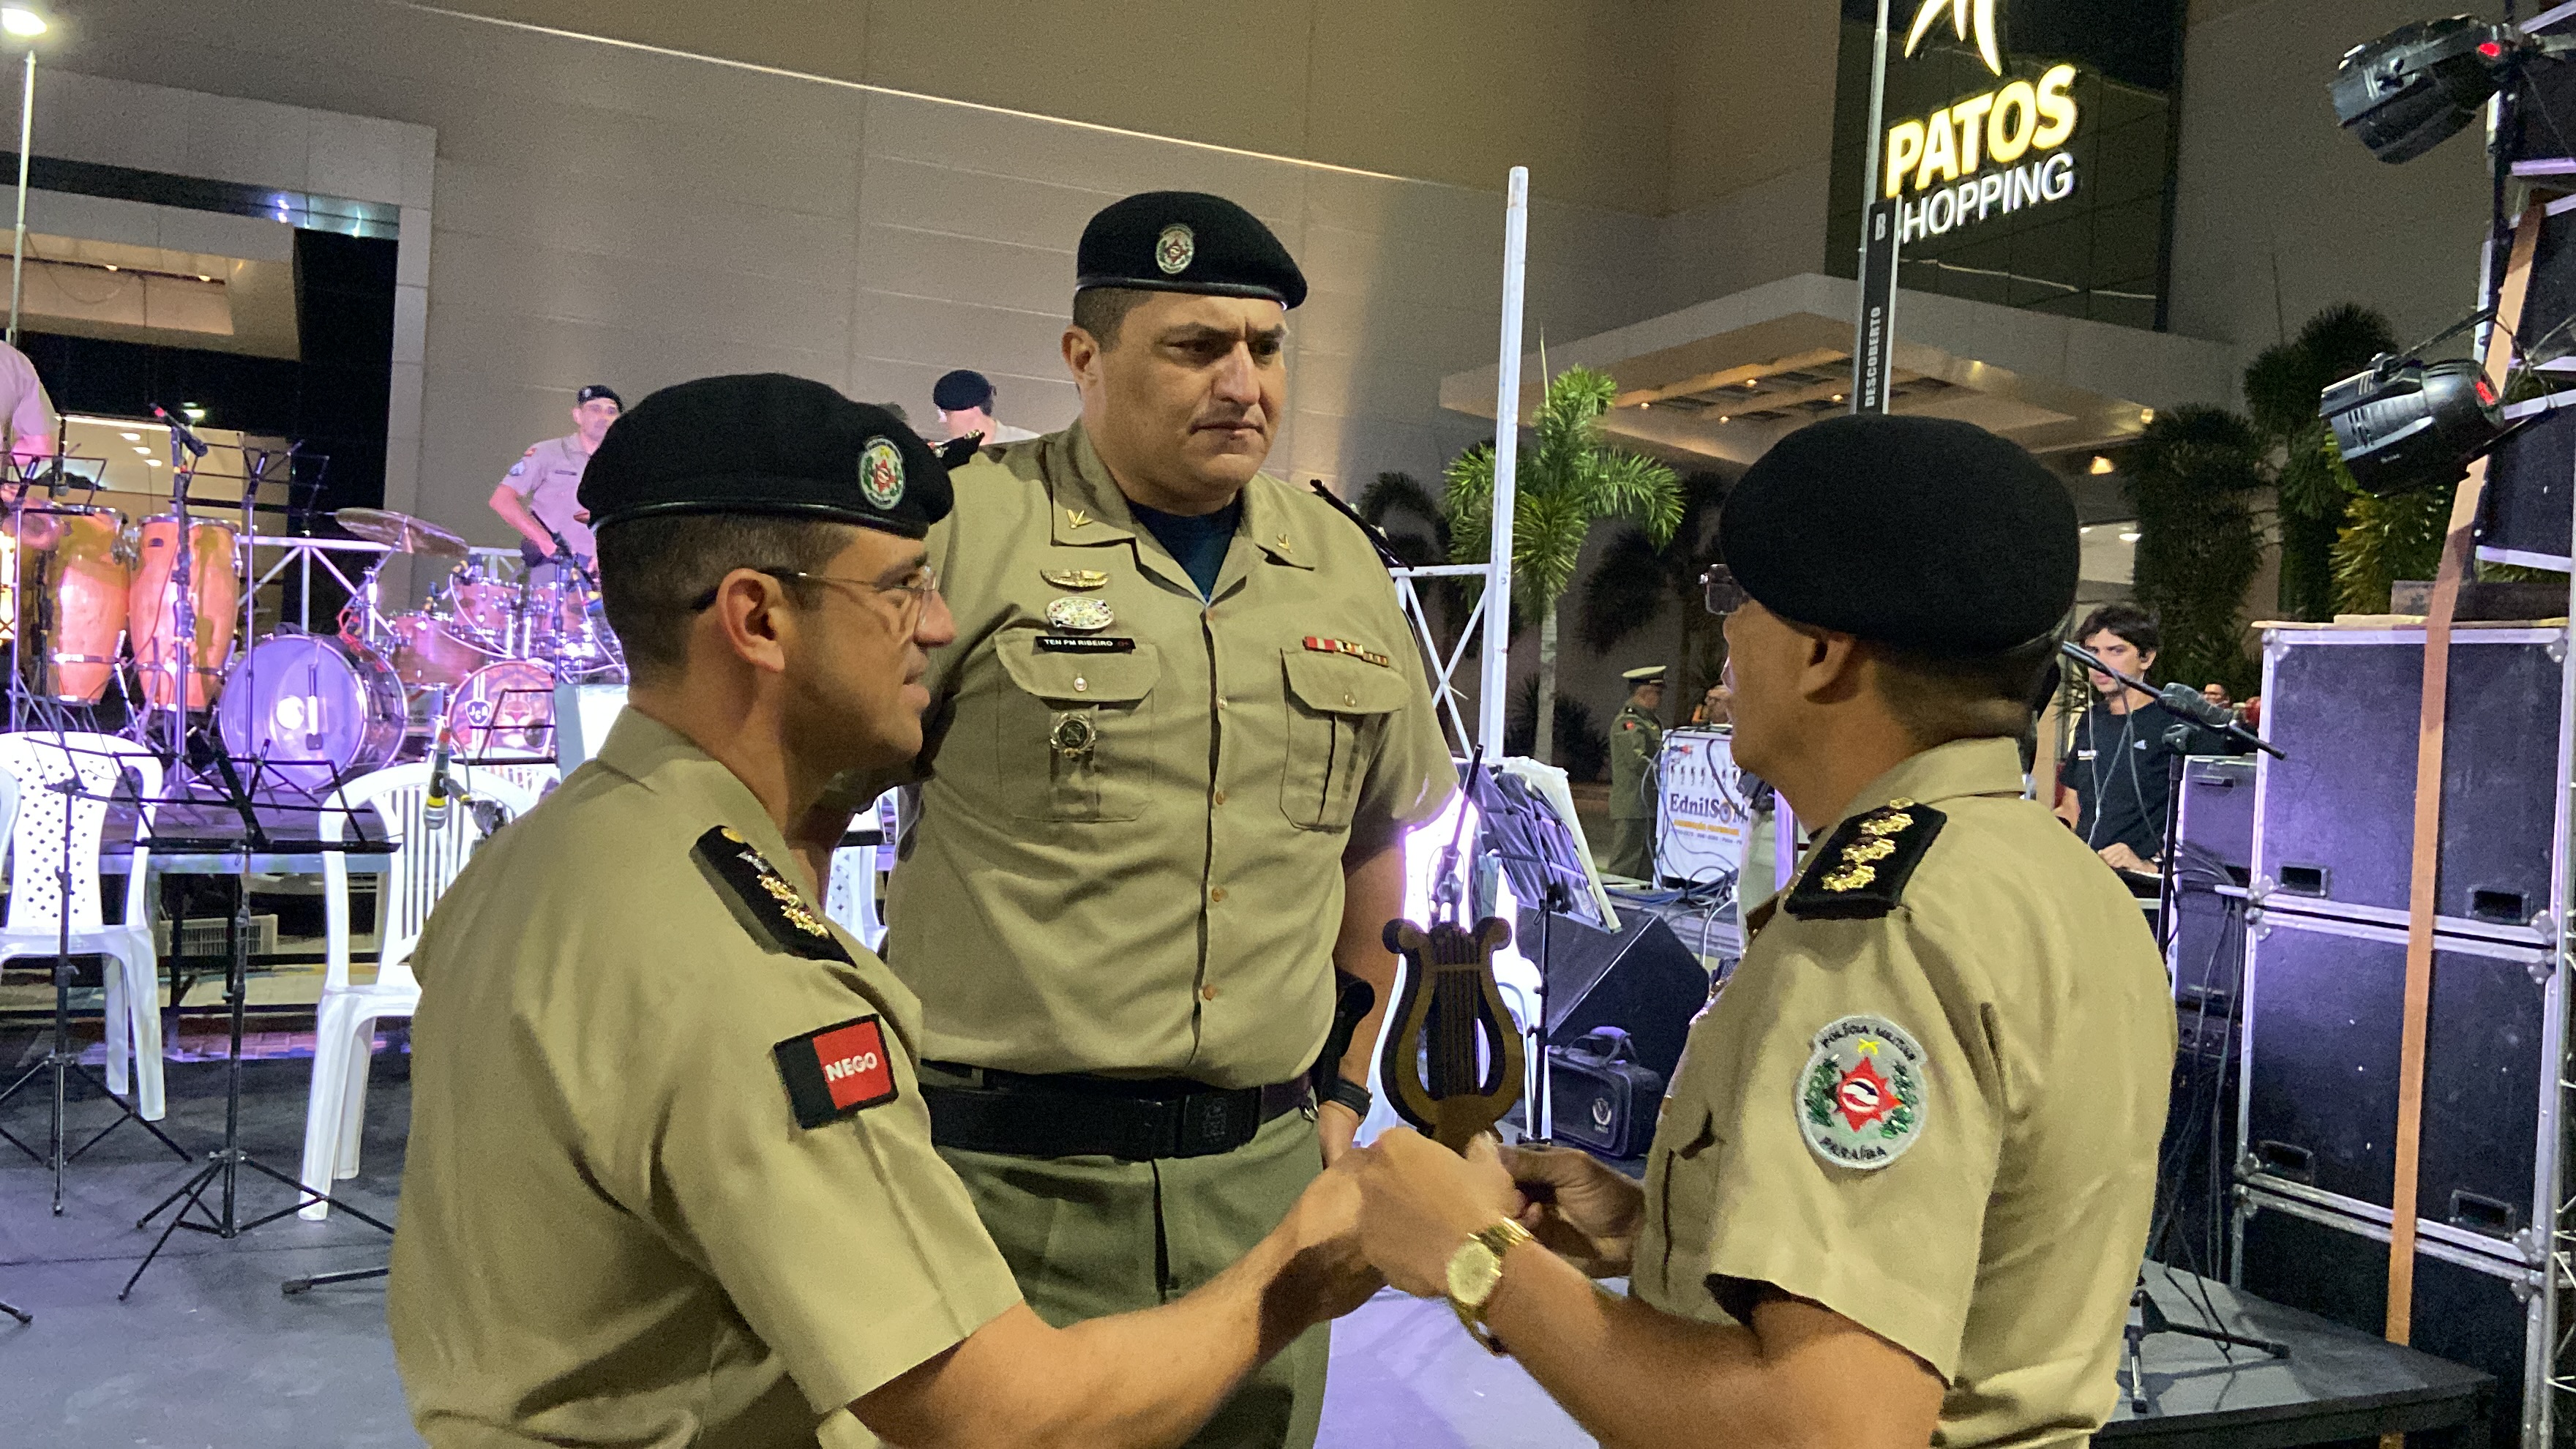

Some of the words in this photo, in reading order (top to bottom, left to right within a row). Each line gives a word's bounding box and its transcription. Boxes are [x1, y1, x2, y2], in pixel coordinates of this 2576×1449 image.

[1886, 64, 2077, 198] PATOS
[1899, 153, 2074, 244] HOPPING
[1865, 307, 1881, 407] DESCOBERTO
[825, 1052, 877, 1082] NEGO
